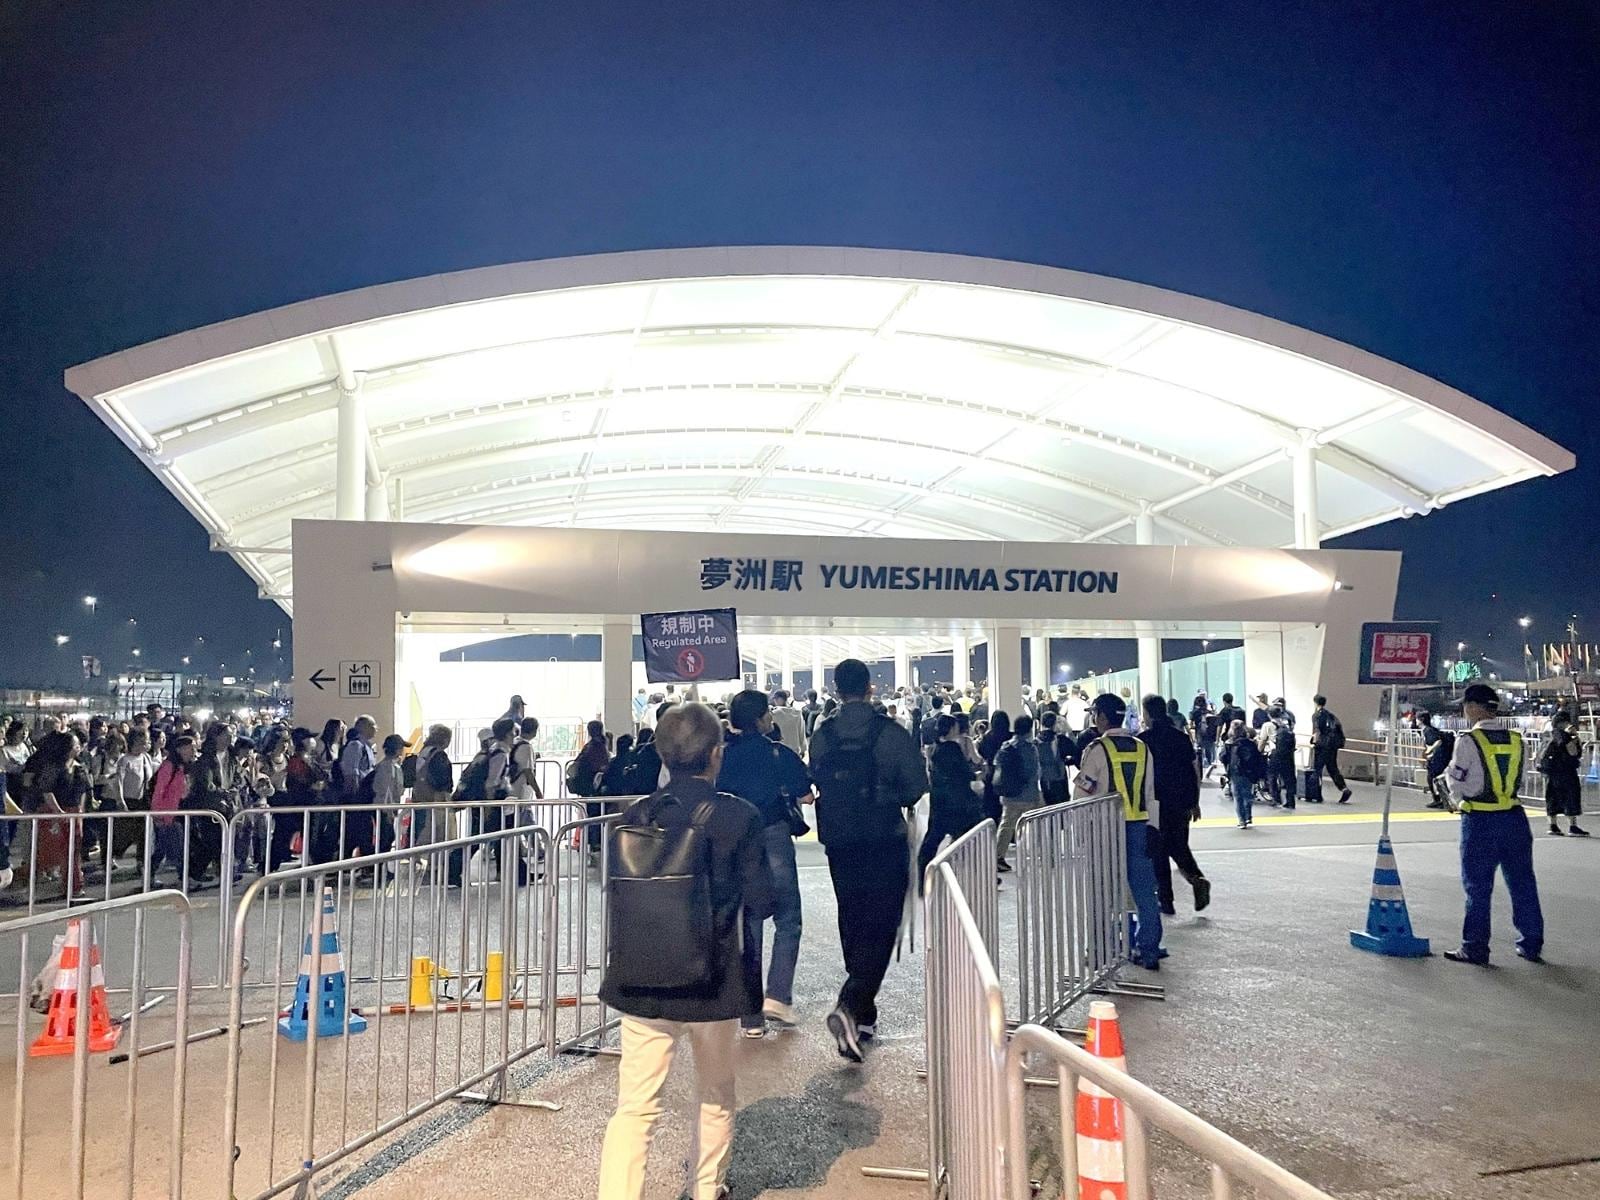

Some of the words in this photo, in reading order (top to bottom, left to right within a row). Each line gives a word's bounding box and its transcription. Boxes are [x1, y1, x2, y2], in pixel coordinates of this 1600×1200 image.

[700, 557, 803, 592] 夢洲駅
[819, 564, 1000, 592] YUMESHIMA
[1003, 568, 1119, 593] STATION
[661, 615, 714, 635] 規制中
[652, 636, 701, 648] Regulated
[703, 635, 727, 645] Area
